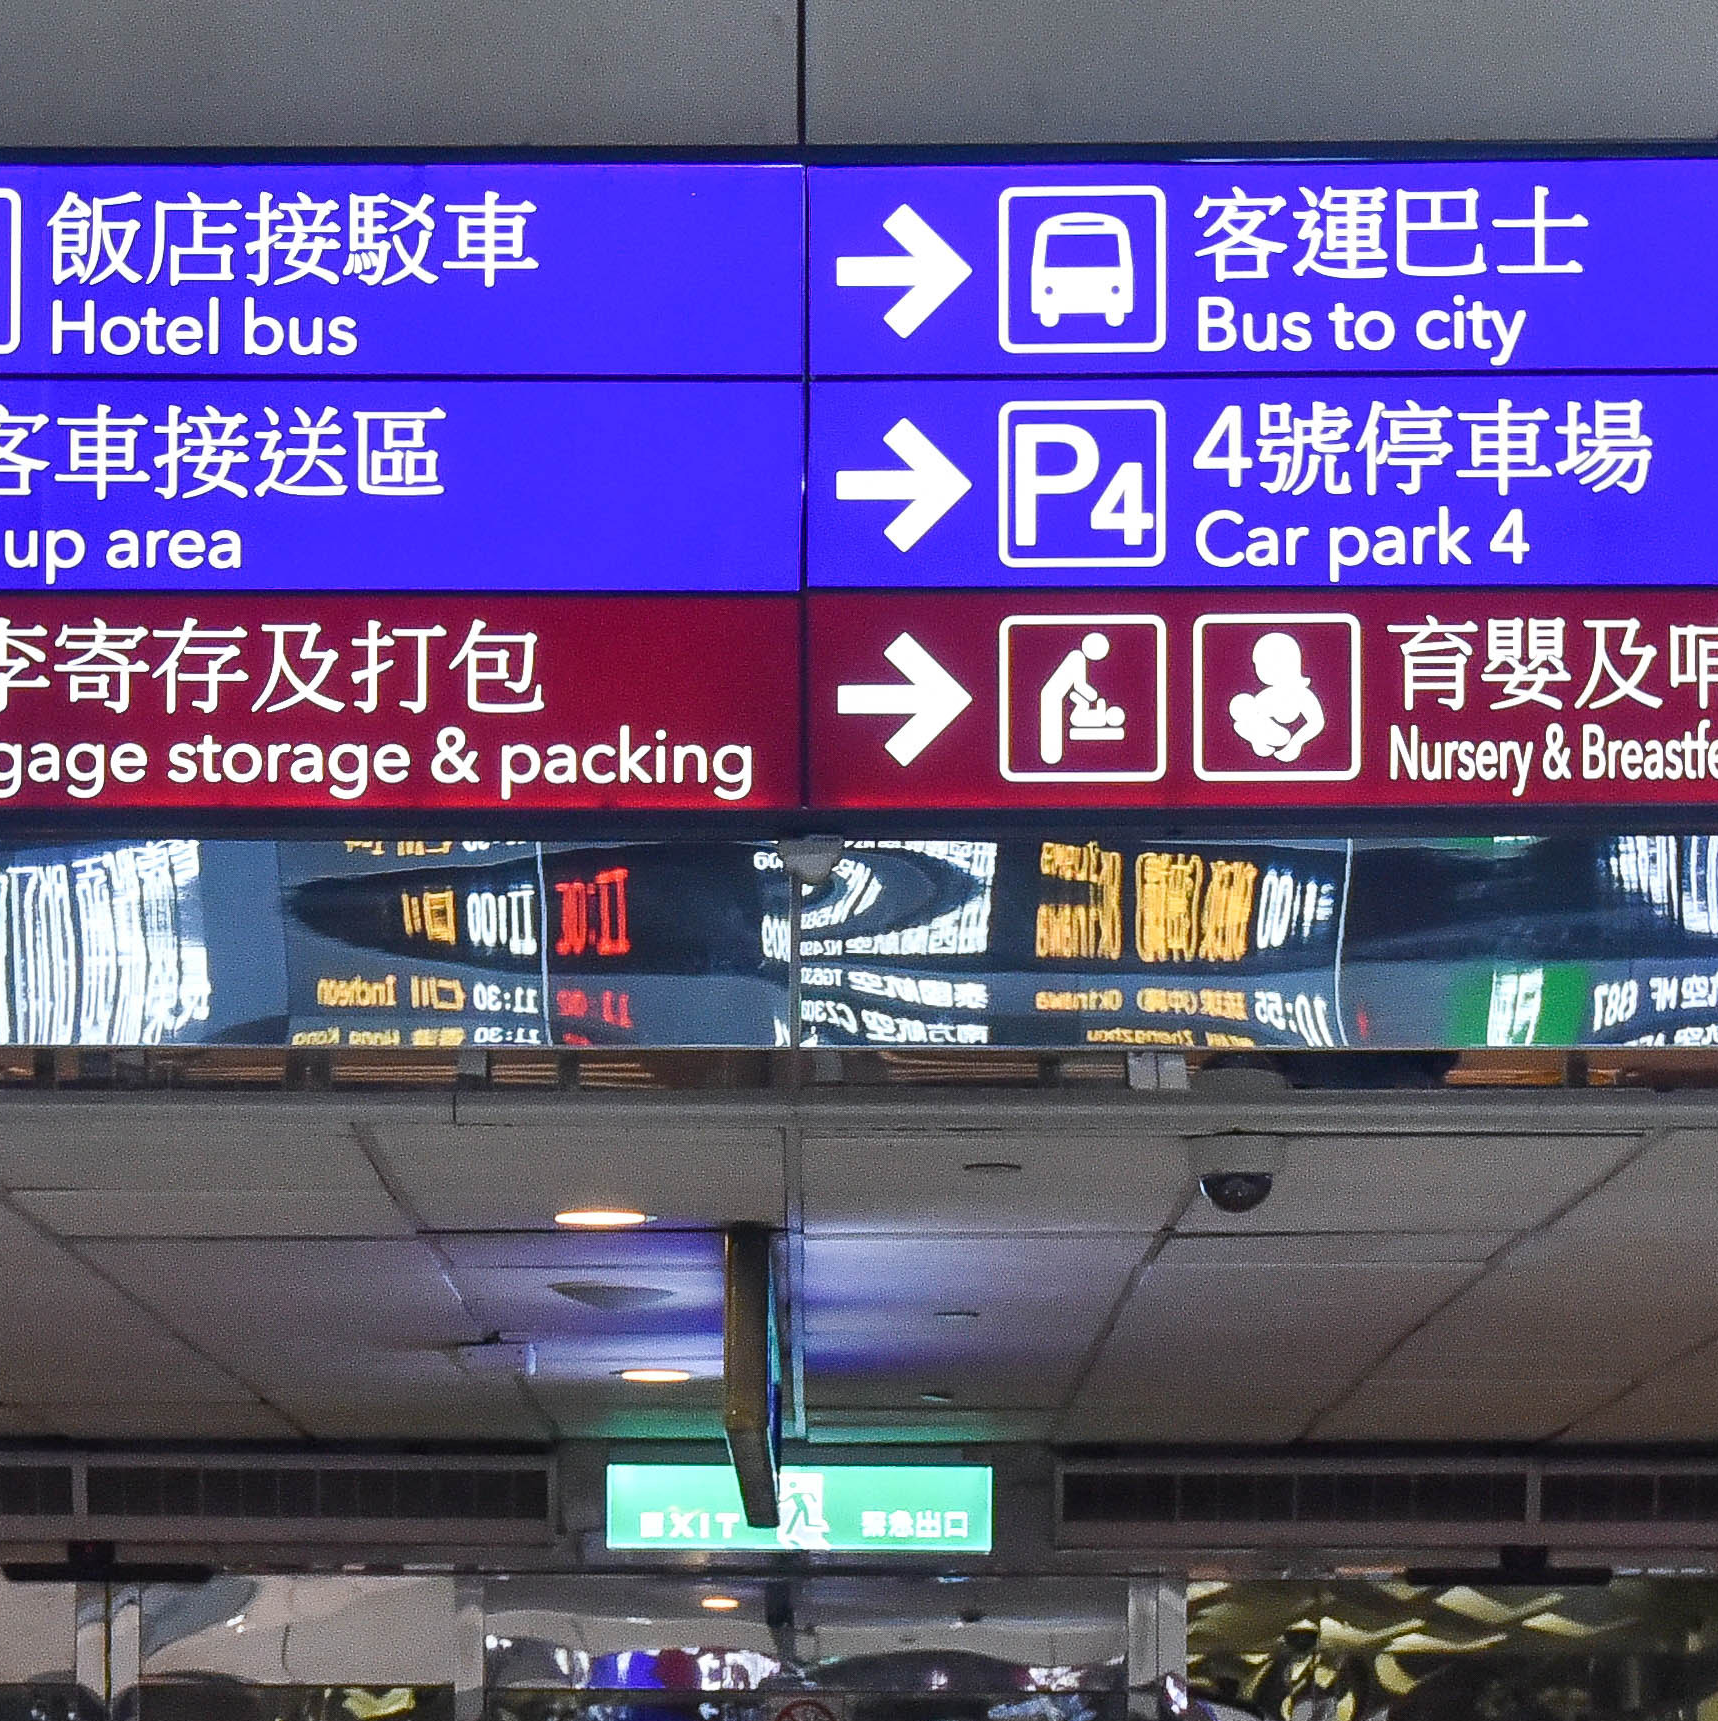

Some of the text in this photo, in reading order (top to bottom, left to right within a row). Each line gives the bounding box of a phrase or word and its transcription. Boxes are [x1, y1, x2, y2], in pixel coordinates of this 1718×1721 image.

[46, 190, 540, 288] 飯店接駁車
[1193, 185, 1590, 283] 客運巴士
[51, 296, 358, 356] Hotel bus
[1197, 294, 1527, 367] Bus to city
[1014, 422, 1154, 548] P4
[1192, 398, 1654, 497] 4號停車場
[4, 528, 86, 585] up
[105, 529, 242, 570] area
[1195, 505, 1531, 583] Car park 4
[167, 734, 411, 800] storage
[430, 726, 481, 784] &
[500, 724, 753, 801] packing
[1389, 724, 1534, 797] Nursery
[1542, 722, 1572, 781] &
